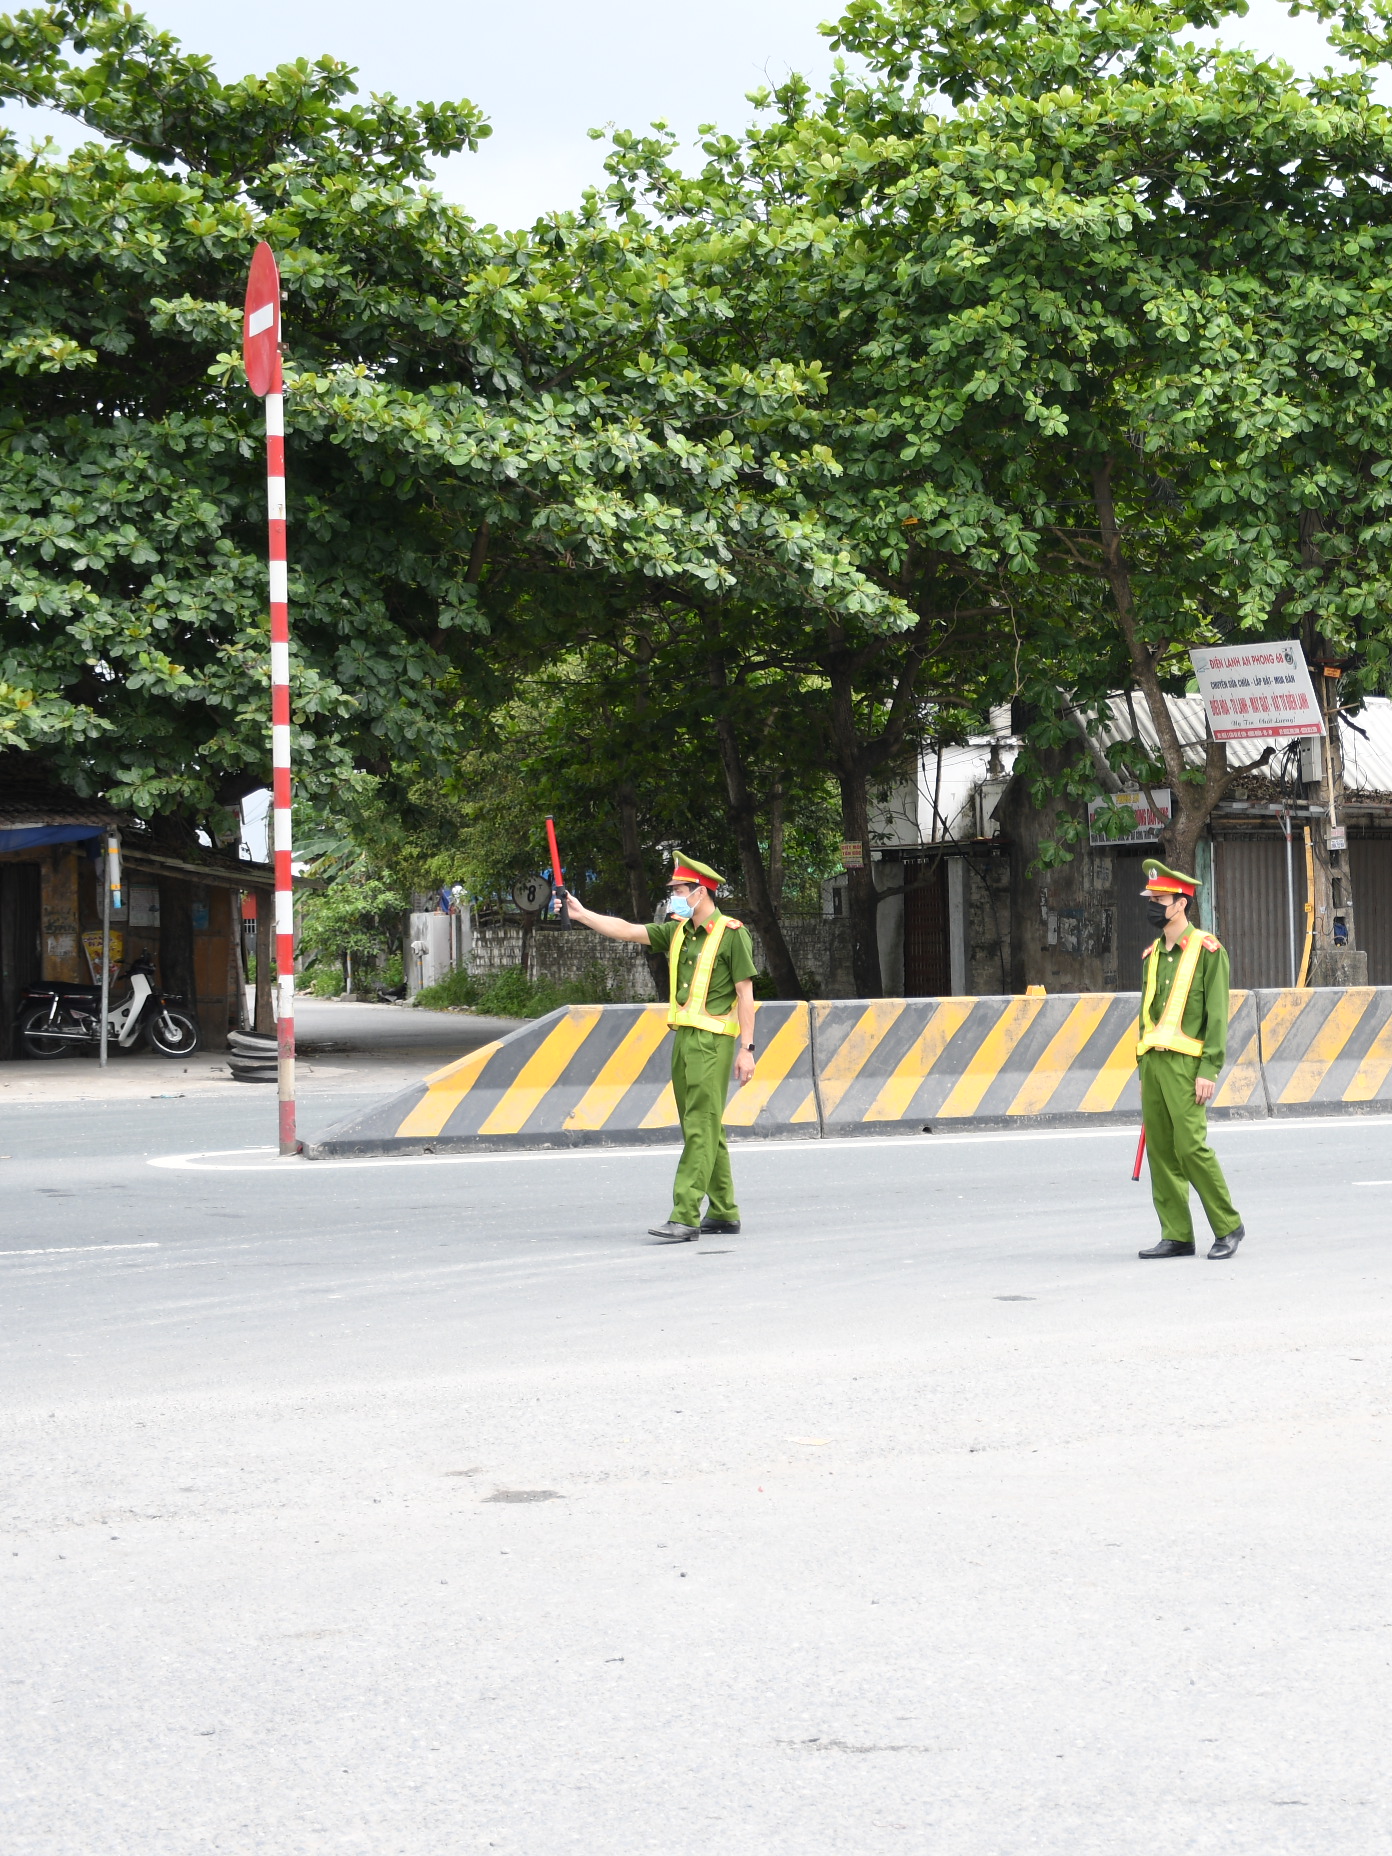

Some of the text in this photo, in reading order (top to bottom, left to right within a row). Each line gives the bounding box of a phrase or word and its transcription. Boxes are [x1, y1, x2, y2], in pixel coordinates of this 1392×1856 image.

[1242, 655, 1251, 667] AN
[1251, 653, 1275, 666] PHONG
[1275, 652, 1284, 664] 68
